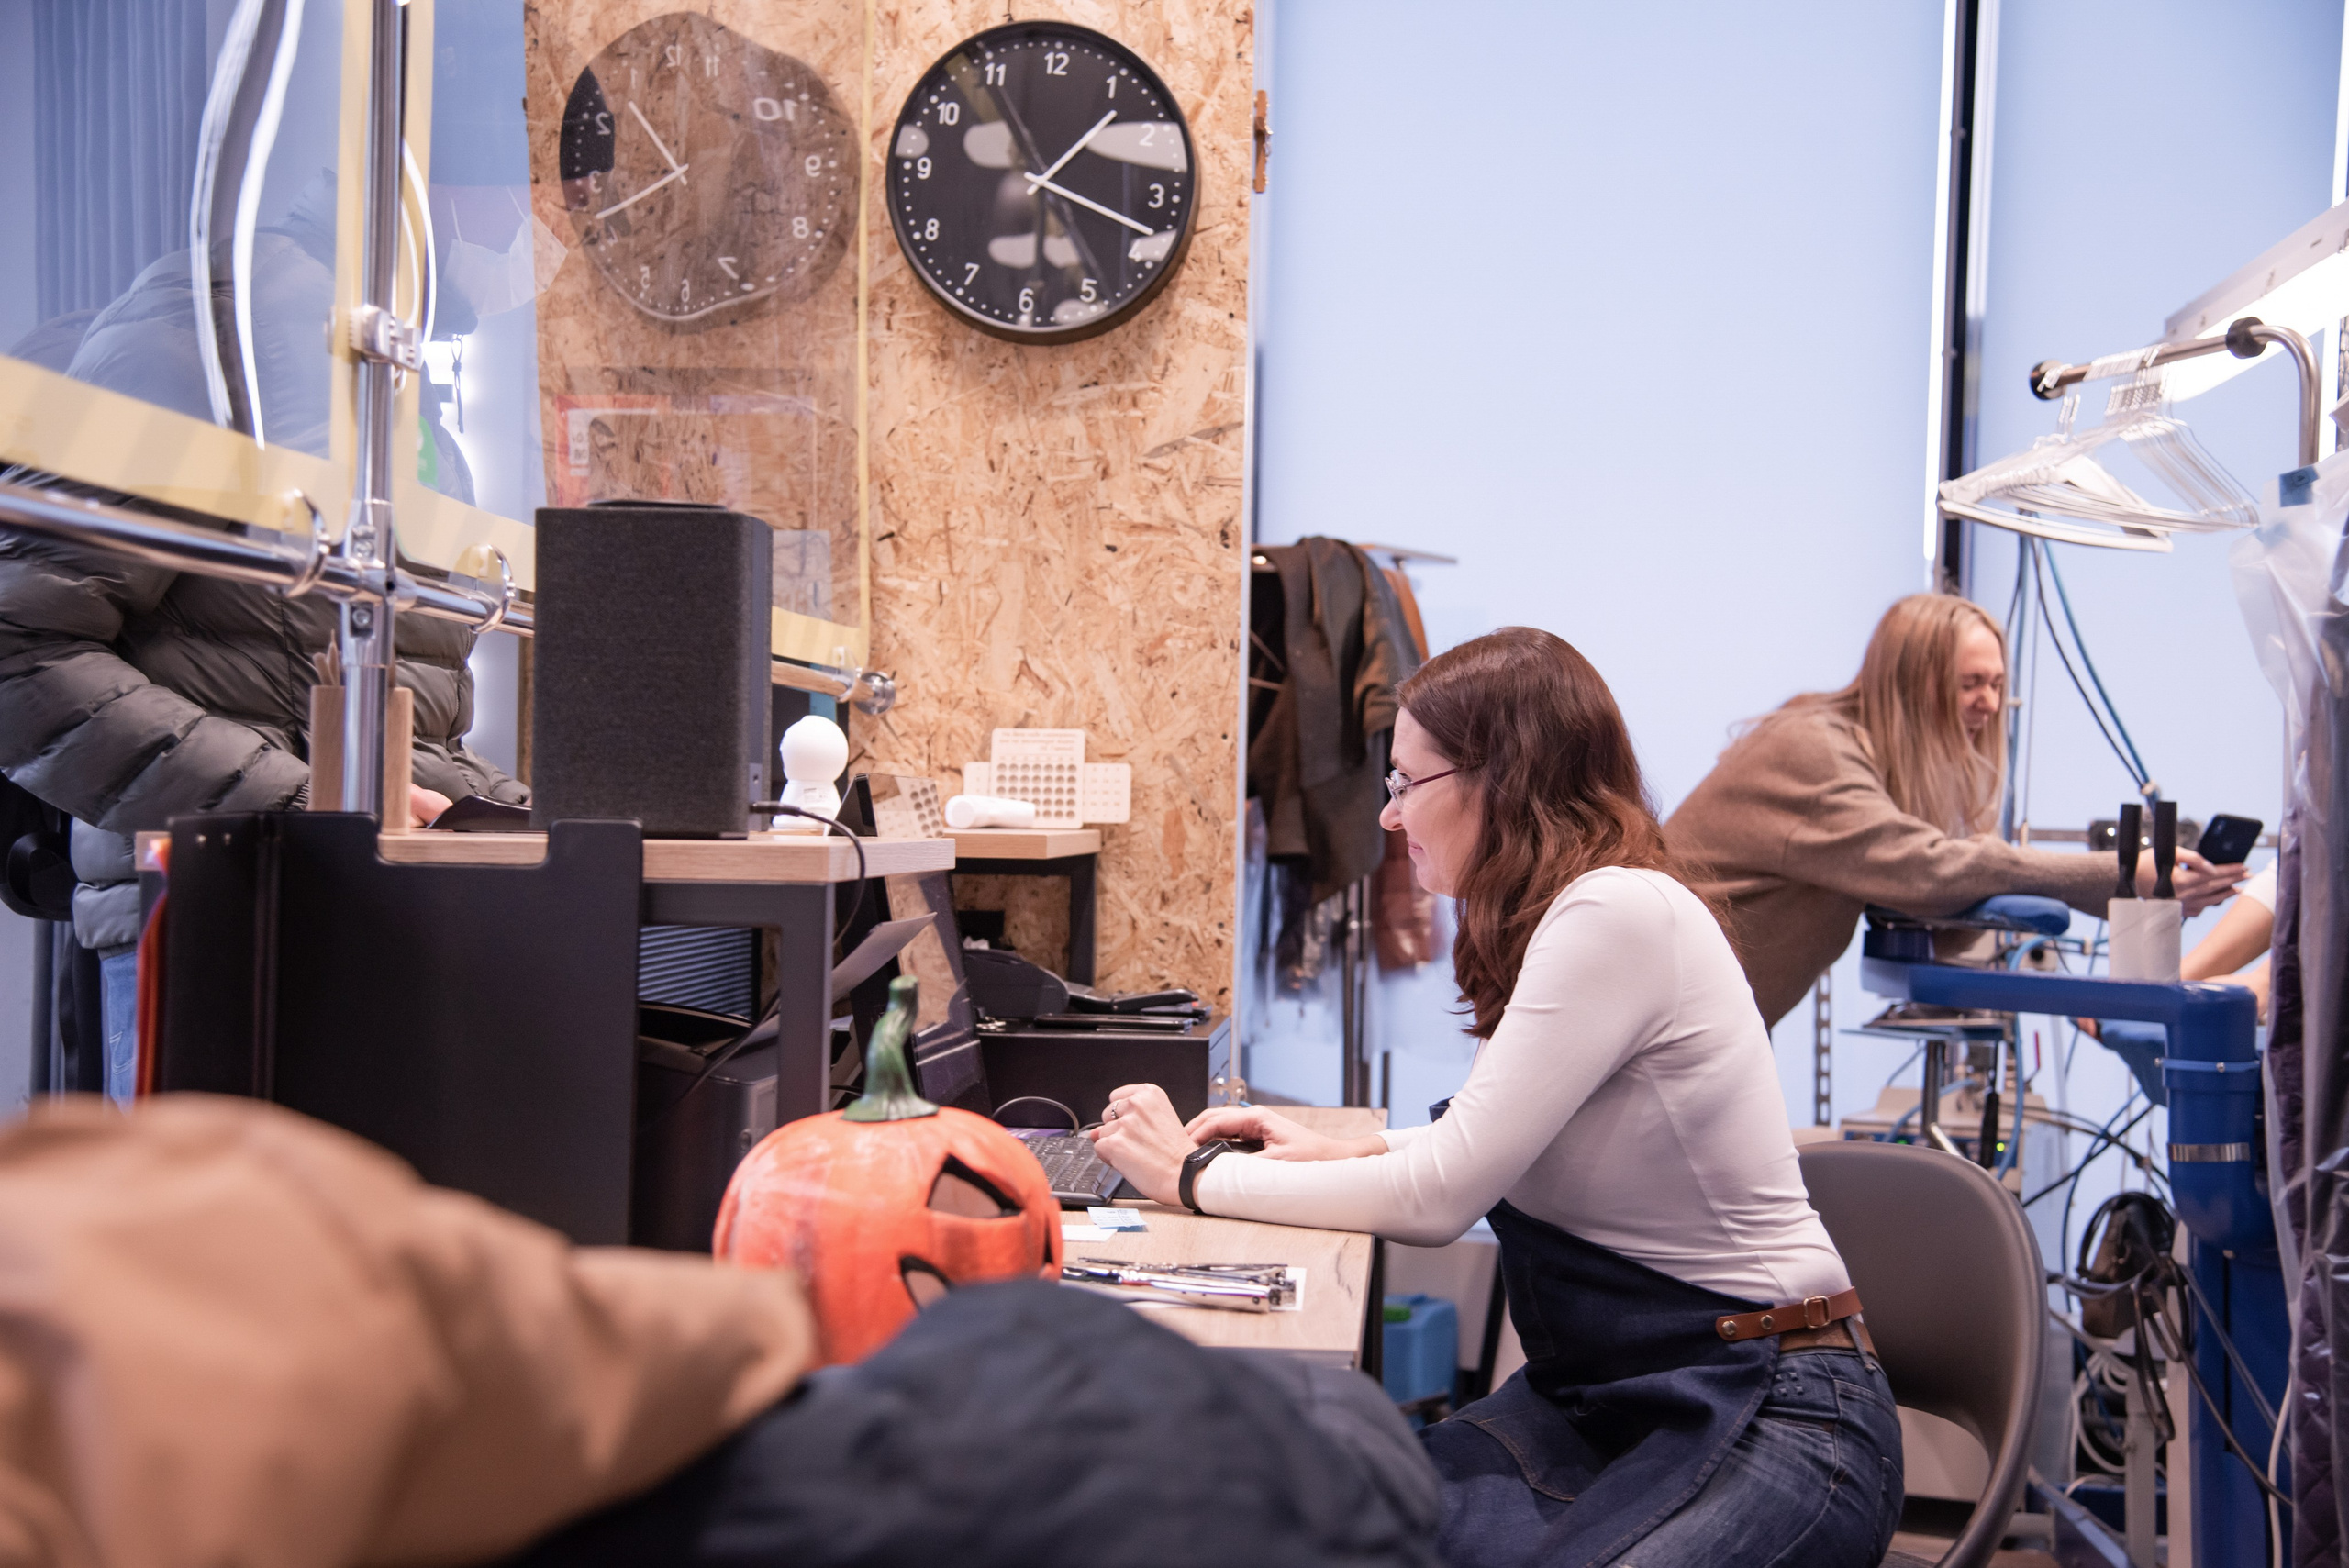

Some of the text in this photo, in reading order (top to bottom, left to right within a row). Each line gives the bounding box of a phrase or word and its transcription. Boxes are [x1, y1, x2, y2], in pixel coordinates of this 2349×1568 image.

[985, 63, 1007, 86] 11
[1044, 52, 1069, 76] 12
[1106, 75, 1117, 99] 1
[937, 101, 960, 126] 10
[1139, 123, 1156, 147] 2
[916, 157, 932, 180] 9
[1148, 183, 1165, 208] 3
[924, 218, 940, 241] 8
[1128, 239, 1142, 262] 4
[964, 262, 980, 286] 7
[1018, 287, 1034, 313] 6
[1079, 278, 1097, 303] 5
